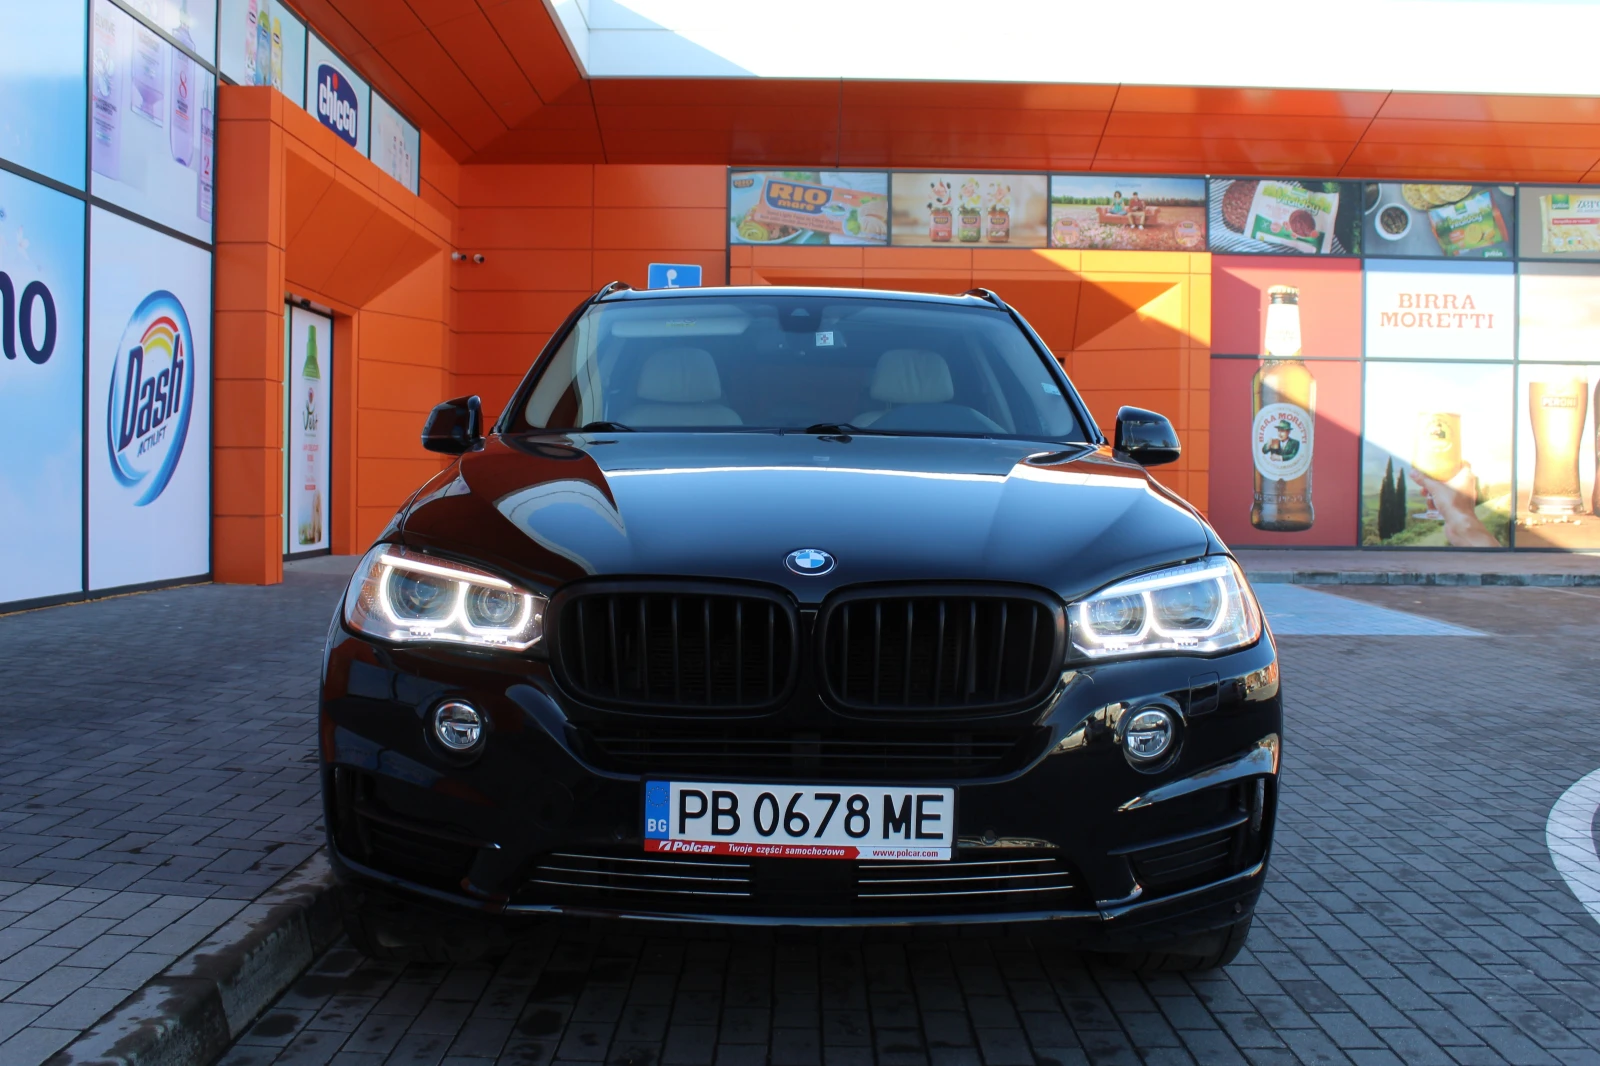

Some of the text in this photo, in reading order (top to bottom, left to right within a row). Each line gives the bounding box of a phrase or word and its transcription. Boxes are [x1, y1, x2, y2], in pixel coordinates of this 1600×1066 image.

[319, 73, 357, 138] chicco
[769, 182, 828, 205] RIO
[777, 199, 815, 212] mare
[1398, 293, 1476, 310] BIRRA
[1380, 311, 1495, 329] MORETTI
[118, 333, 184, 453] Dash
[1259, 412, 1308, 444] BIRRA MORETTI
[137, 424, 167, 457] ACTILIFT
[678, 788, 944, 840] PB 0678 ME
[647, 819, 668, 833] BG
[672, 840, 716, 853] Polcar
[728, 843, 753, 854] Twoje
[756, 844, 783, 856] części
[872, 849, 939, 859] www.polcar.com
